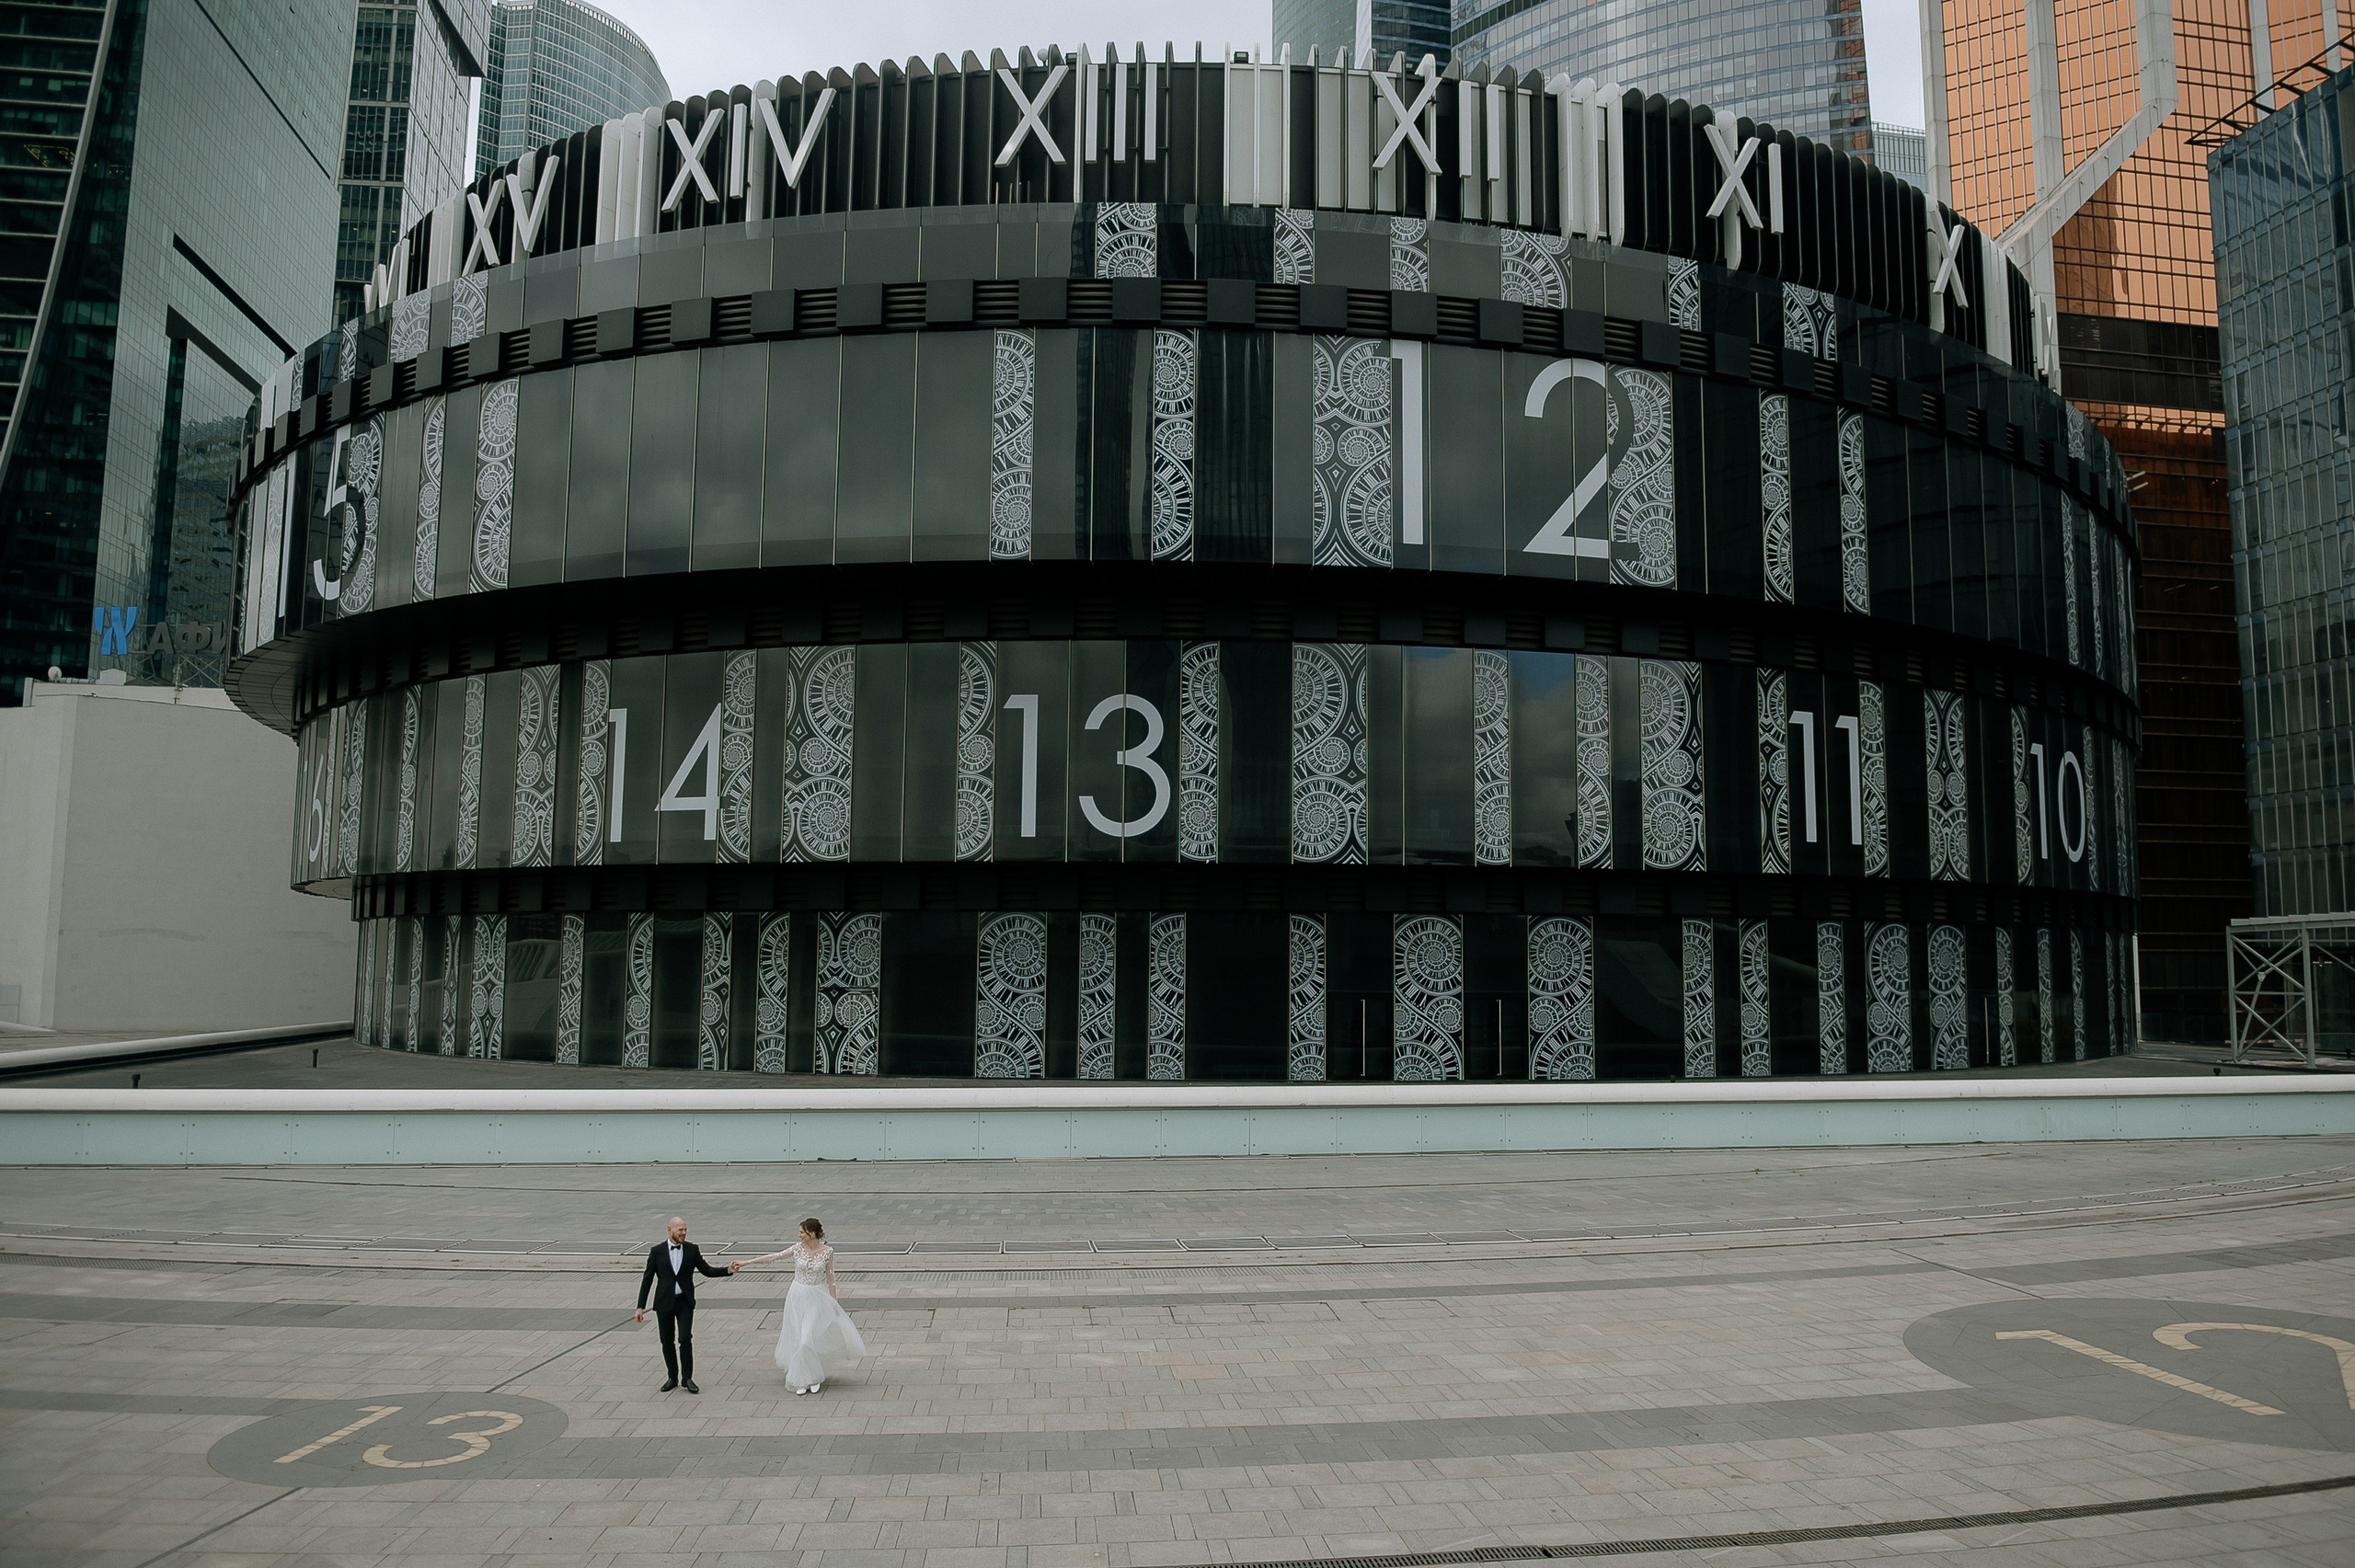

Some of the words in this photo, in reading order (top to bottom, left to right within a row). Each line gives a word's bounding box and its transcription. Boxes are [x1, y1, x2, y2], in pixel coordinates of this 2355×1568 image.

[661, 87, 837, 212] XIV
[994, 63, 1157, 168] XIII
[1372, 71, 1499, 182] XII
[462, 155, 559, 277] XV
[1704, 123, 1784, 235] XI
[1931, 207, 1966, 310] X
[1378, 339, 1639, 560] 12
[278, 422, 368, 619] 15
[609, 703, 722, 842] 14
[1003, 693, 1171, 838] 13
[1788, 710, 1863, 845] 11
[2030, 742, 2085, 863] 10
[272, 1404, 524, 1469] 13
